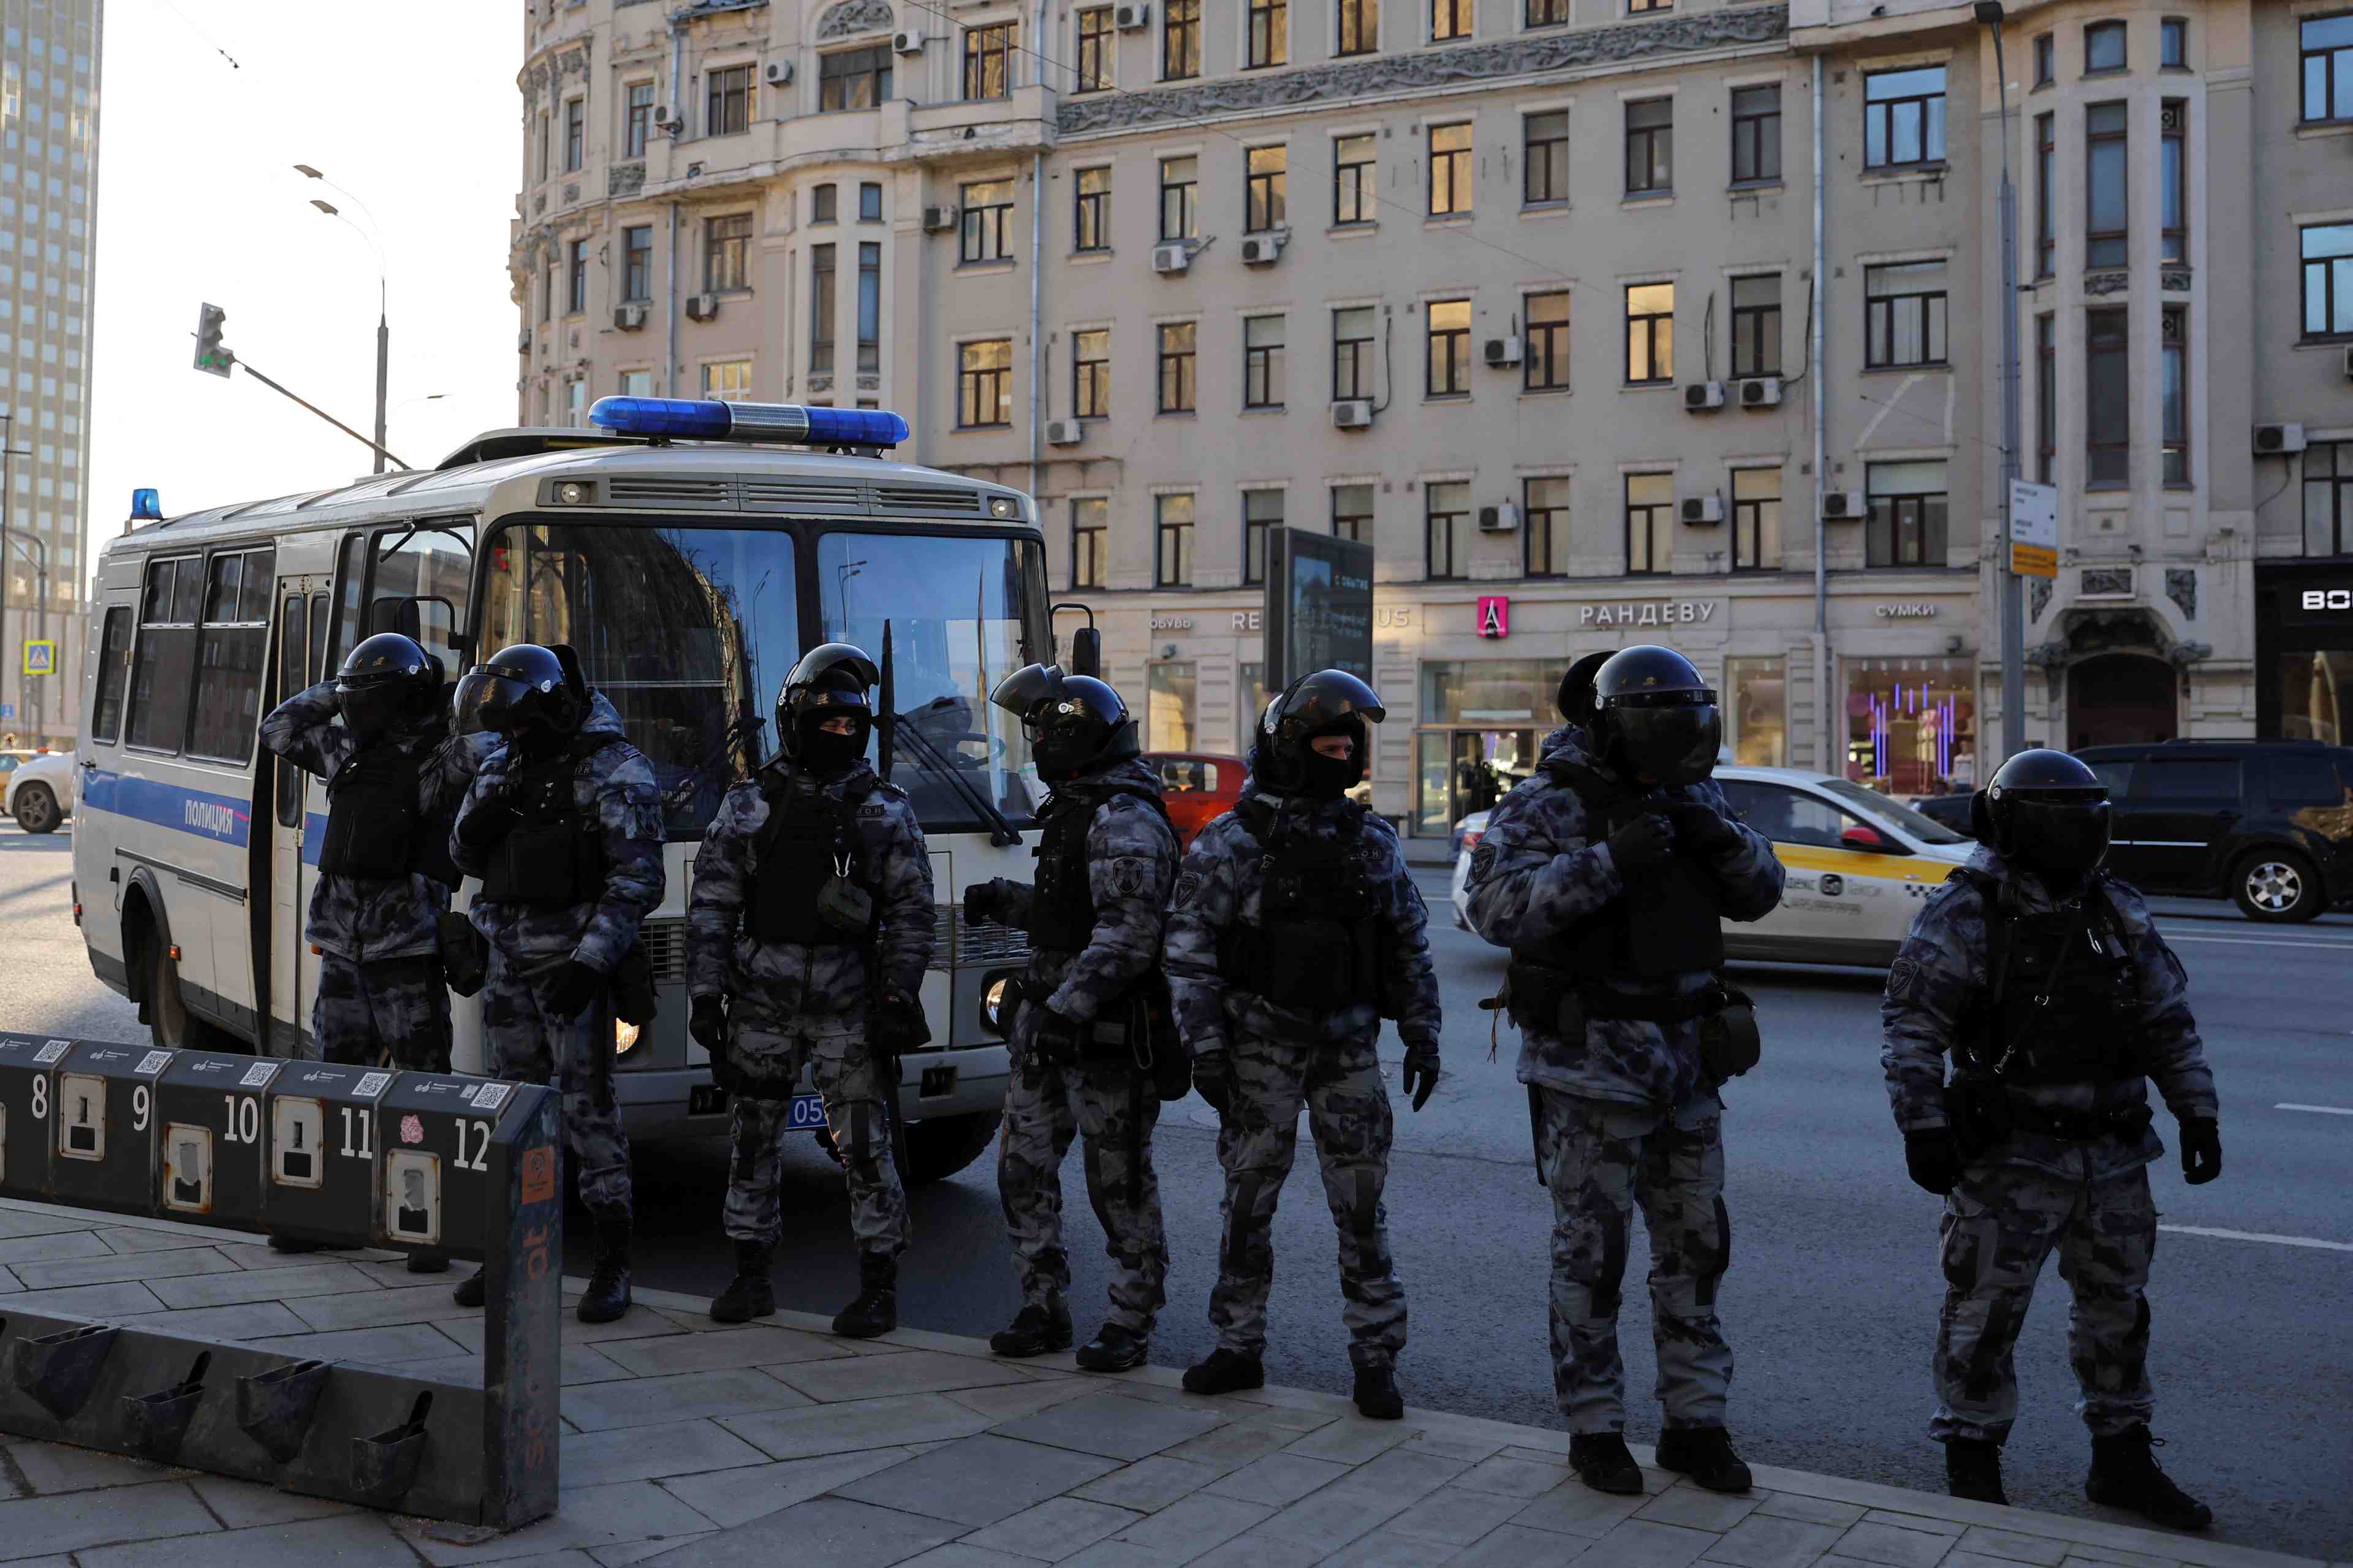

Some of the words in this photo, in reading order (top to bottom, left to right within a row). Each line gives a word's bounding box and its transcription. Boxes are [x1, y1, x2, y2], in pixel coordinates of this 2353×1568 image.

[1580, 602, 1715, 626] РАНДЕВУ
[1876, 604, 1935, 618] СУМКИ
[2303, 589, 2353, 610] BO
[1149, 617, 1192, 630] ОБУВЬ
[186, 799, 233, 836] ПОЛИЦИЯ
[31, 1074, 48, 1119] 8
[132, 1085, 150, 1131] 9
[224, 1095, 258, 1144] 10
[340, 1107, 373, 1159] 11
[454, 1118, 490, 1172] 12
